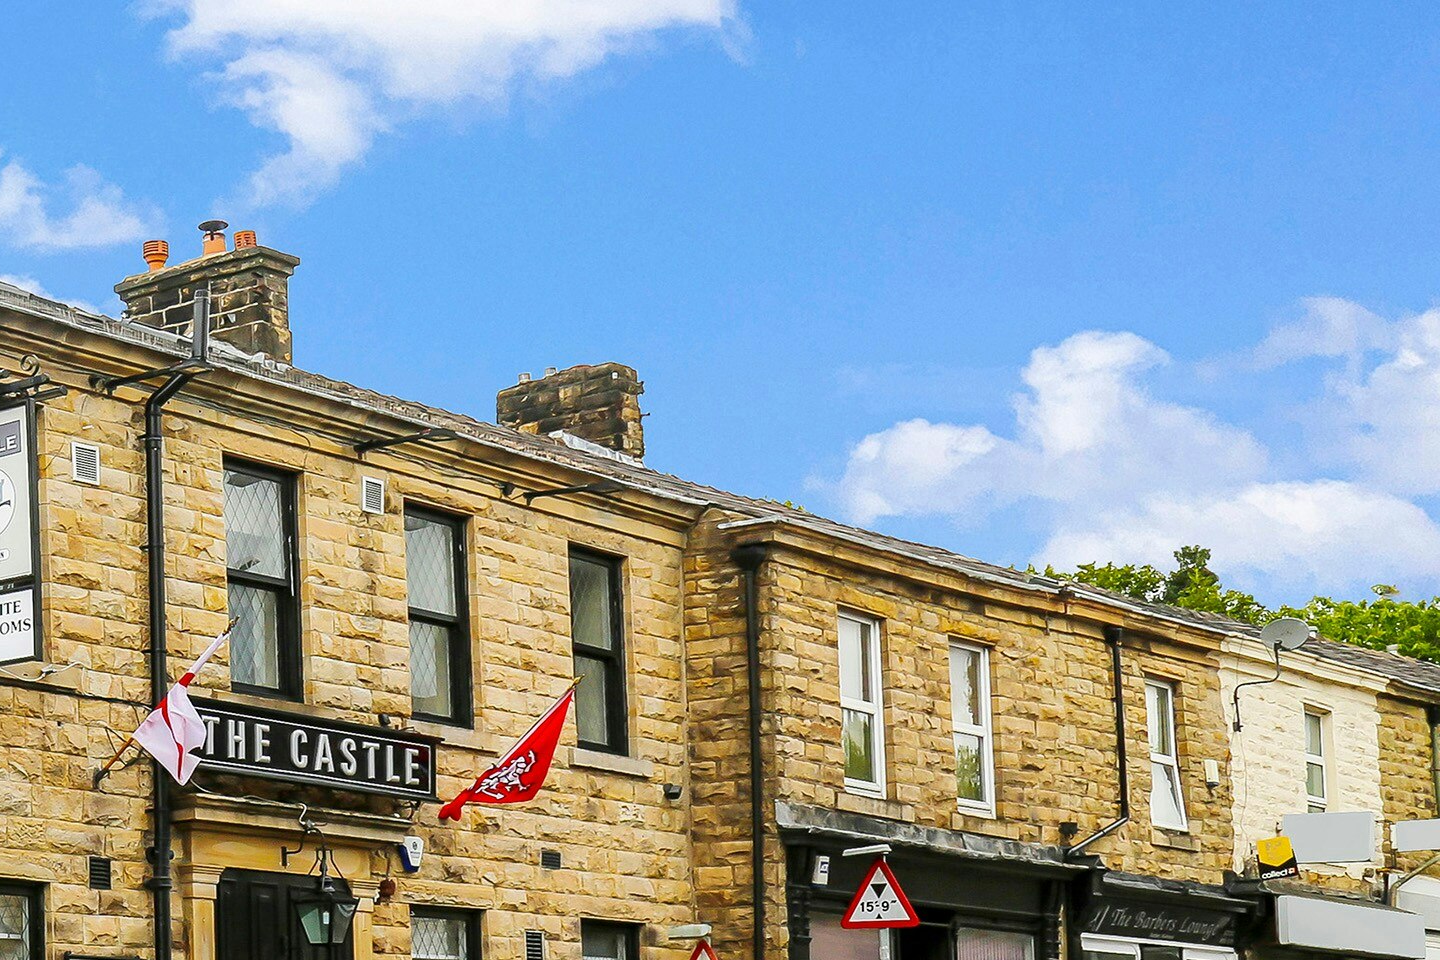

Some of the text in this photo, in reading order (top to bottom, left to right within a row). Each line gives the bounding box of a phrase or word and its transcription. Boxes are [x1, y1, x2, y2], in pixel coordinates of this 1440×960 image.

[201, 714, 420, 785] THE CASTLE
[1110, 907, 1132, 927] The
[1133, 911, 1178, 931] Barbers
[1179, 915, 1220, 941] Lounge
